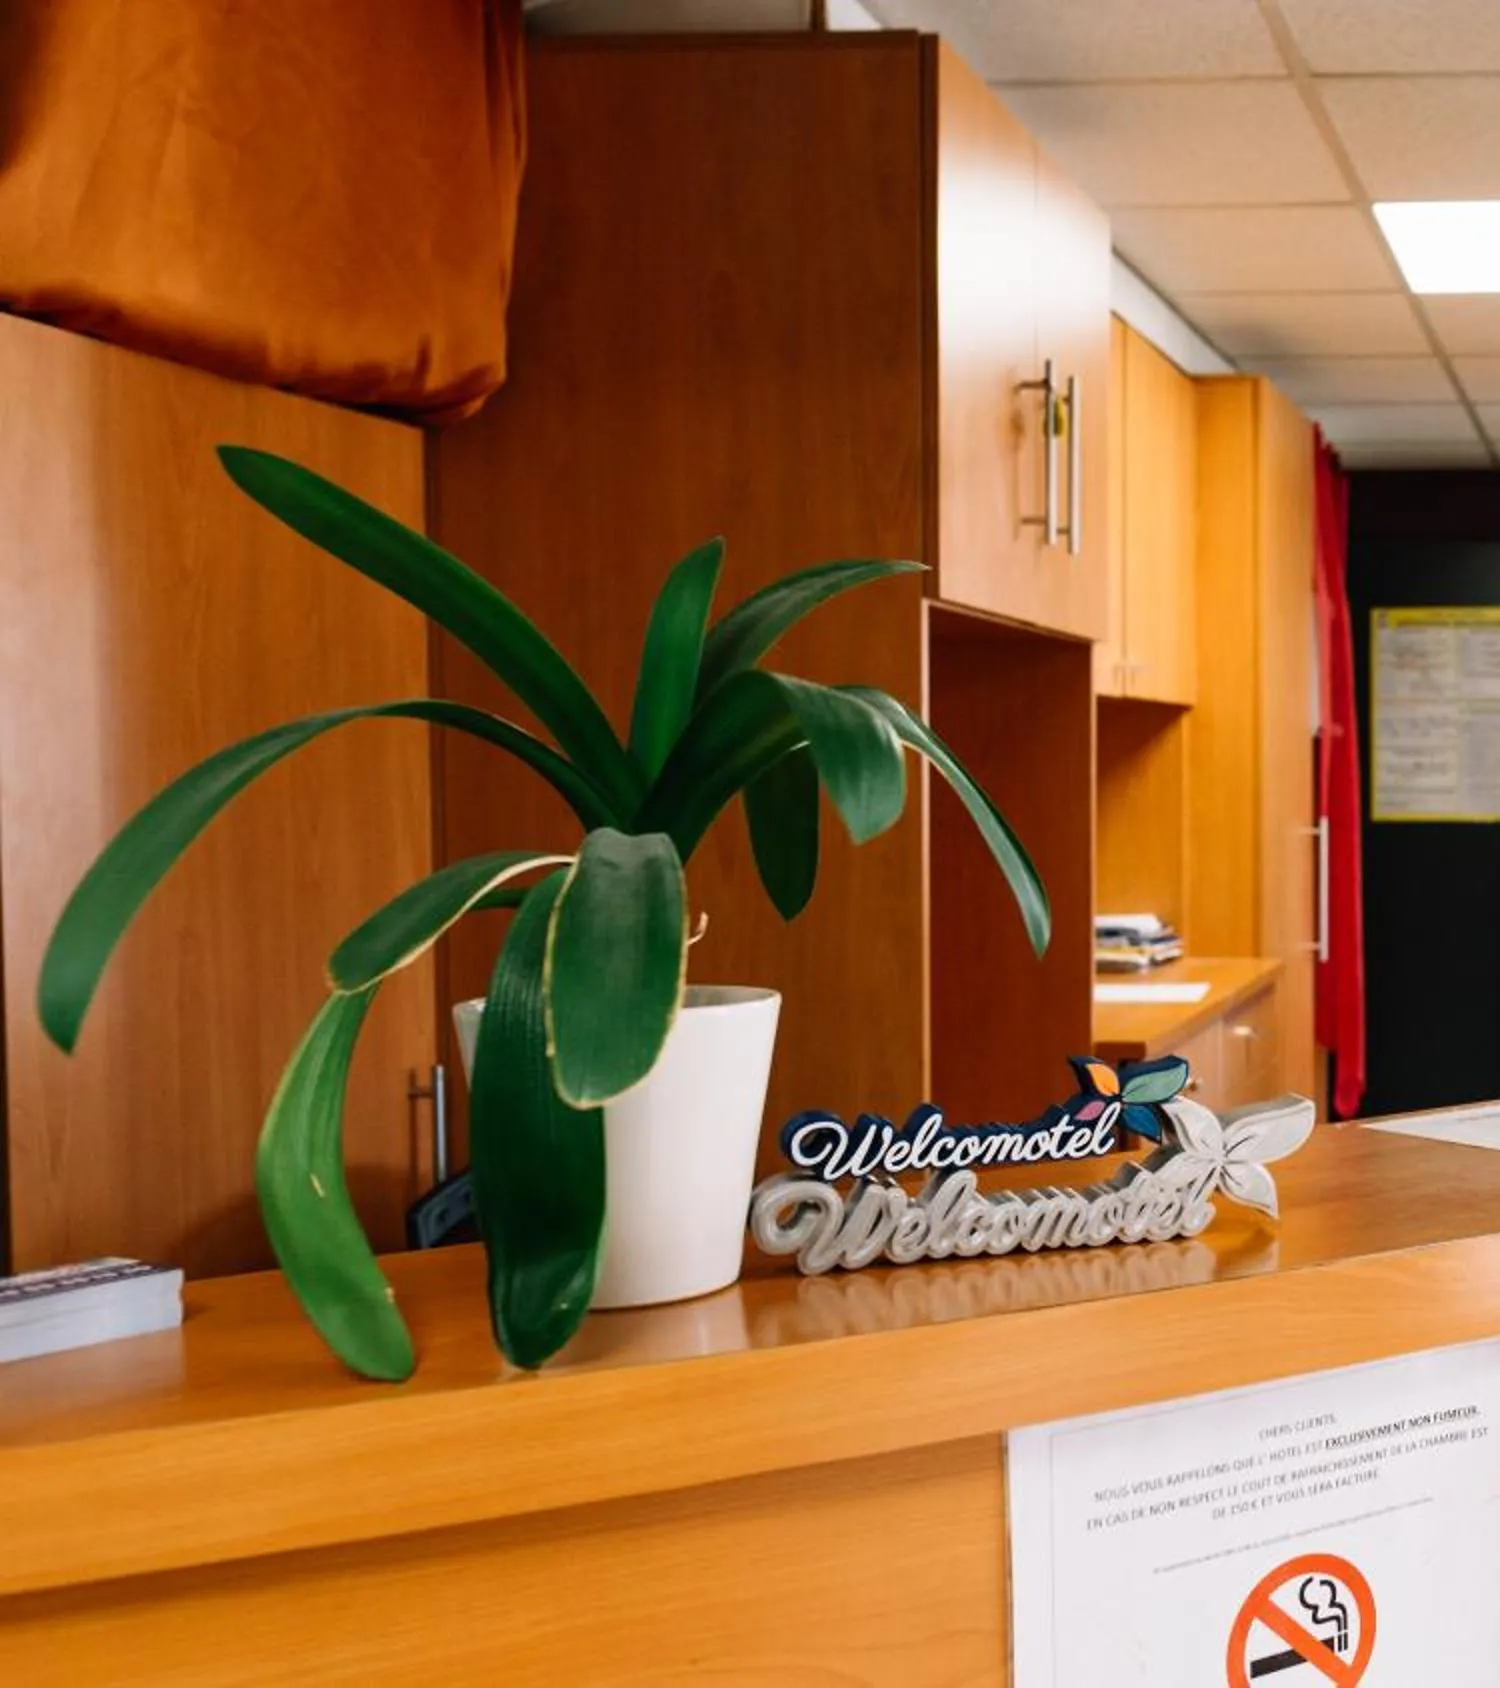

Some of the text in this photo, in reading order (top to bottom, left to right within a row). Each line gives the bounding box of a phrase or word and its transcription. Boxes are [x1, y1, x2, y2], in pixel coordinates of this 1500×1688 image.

[790, 1102, 1120, 1179] Welcomotel
[1131, 1477, 1163, 1495] VOUS
[1325, 1420, 1406, 1450] EXCLUSIVEMENT
[1408, 1414, 1431, 1428] NON
[1149, 1500, 1175, 1516] NON
[1178, 1486, 1223, 1508] RESPECT
[1275, 1486, 1304, 1504] VOUS
